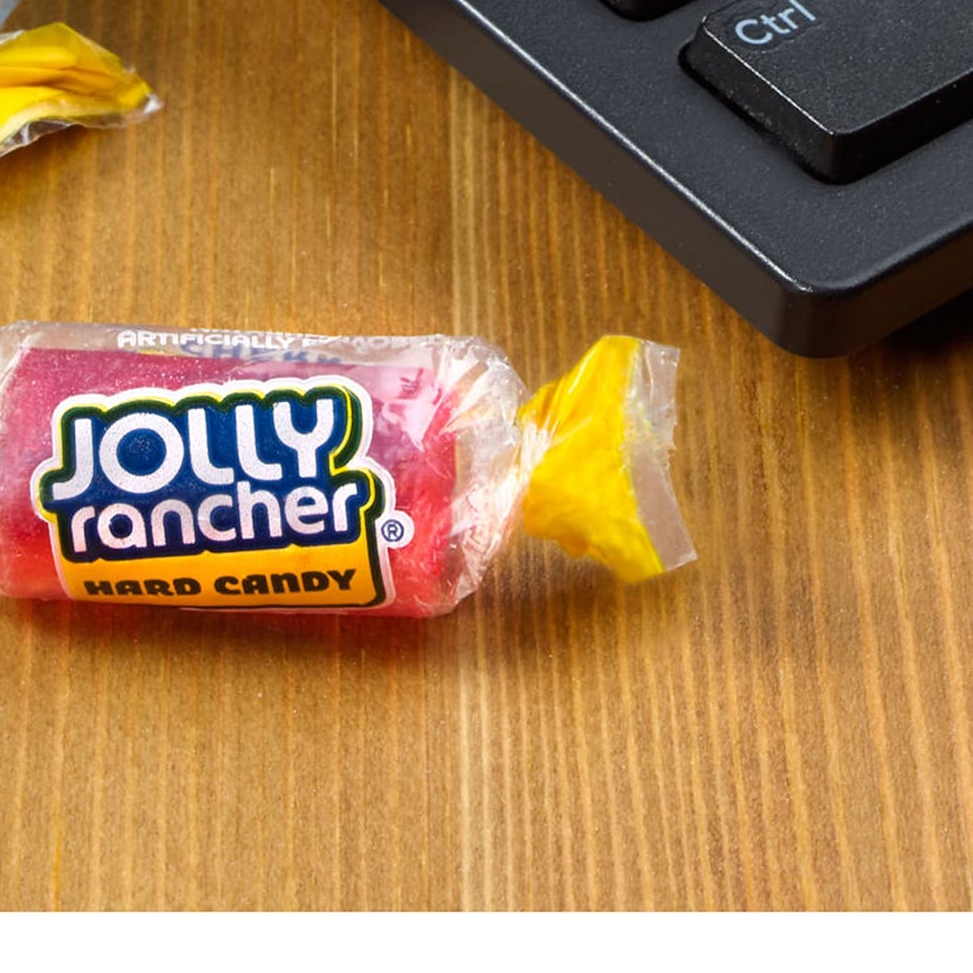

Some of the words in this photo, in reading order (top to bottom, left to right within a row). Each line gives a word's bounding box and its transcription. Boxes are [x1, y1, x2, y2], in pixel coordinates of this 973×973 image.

[117, 330, 296, 350] ARTIFICIALLY
[52, 398, 334, 500] JOLLY
[70, 481, 359, 553] rancher
[83, 577, 202, 596] HARD
[214, 568, 357, 595] CANDY
